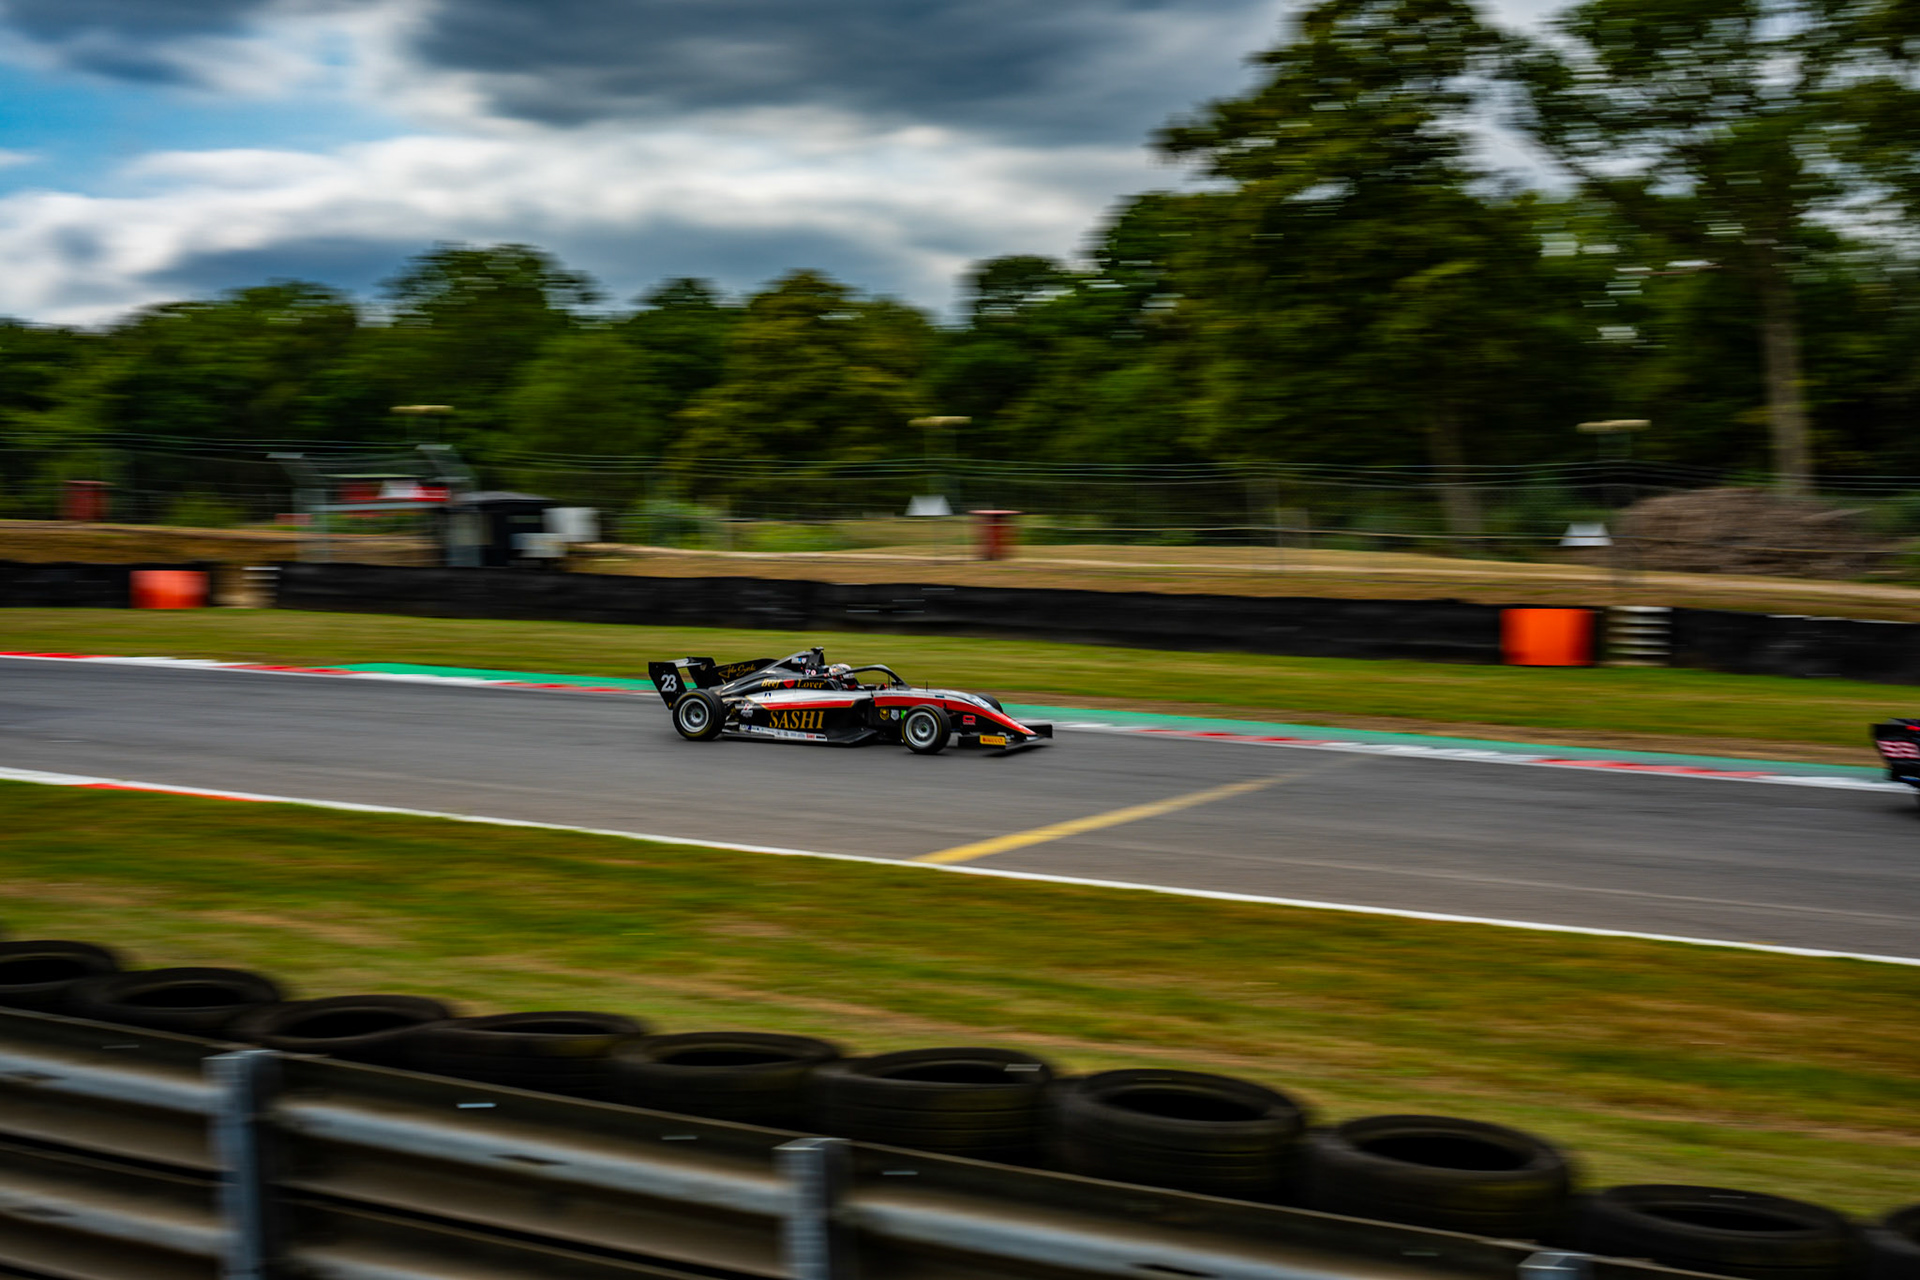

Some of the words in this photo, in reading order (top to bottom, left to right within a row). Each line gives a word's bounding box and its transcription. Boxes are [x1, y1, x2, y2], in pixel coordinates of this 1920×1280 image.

[661, 674, 677, 692] 23
[761, 679, 781, 689] Beef
[769, 711, 825, 729] SASHI
